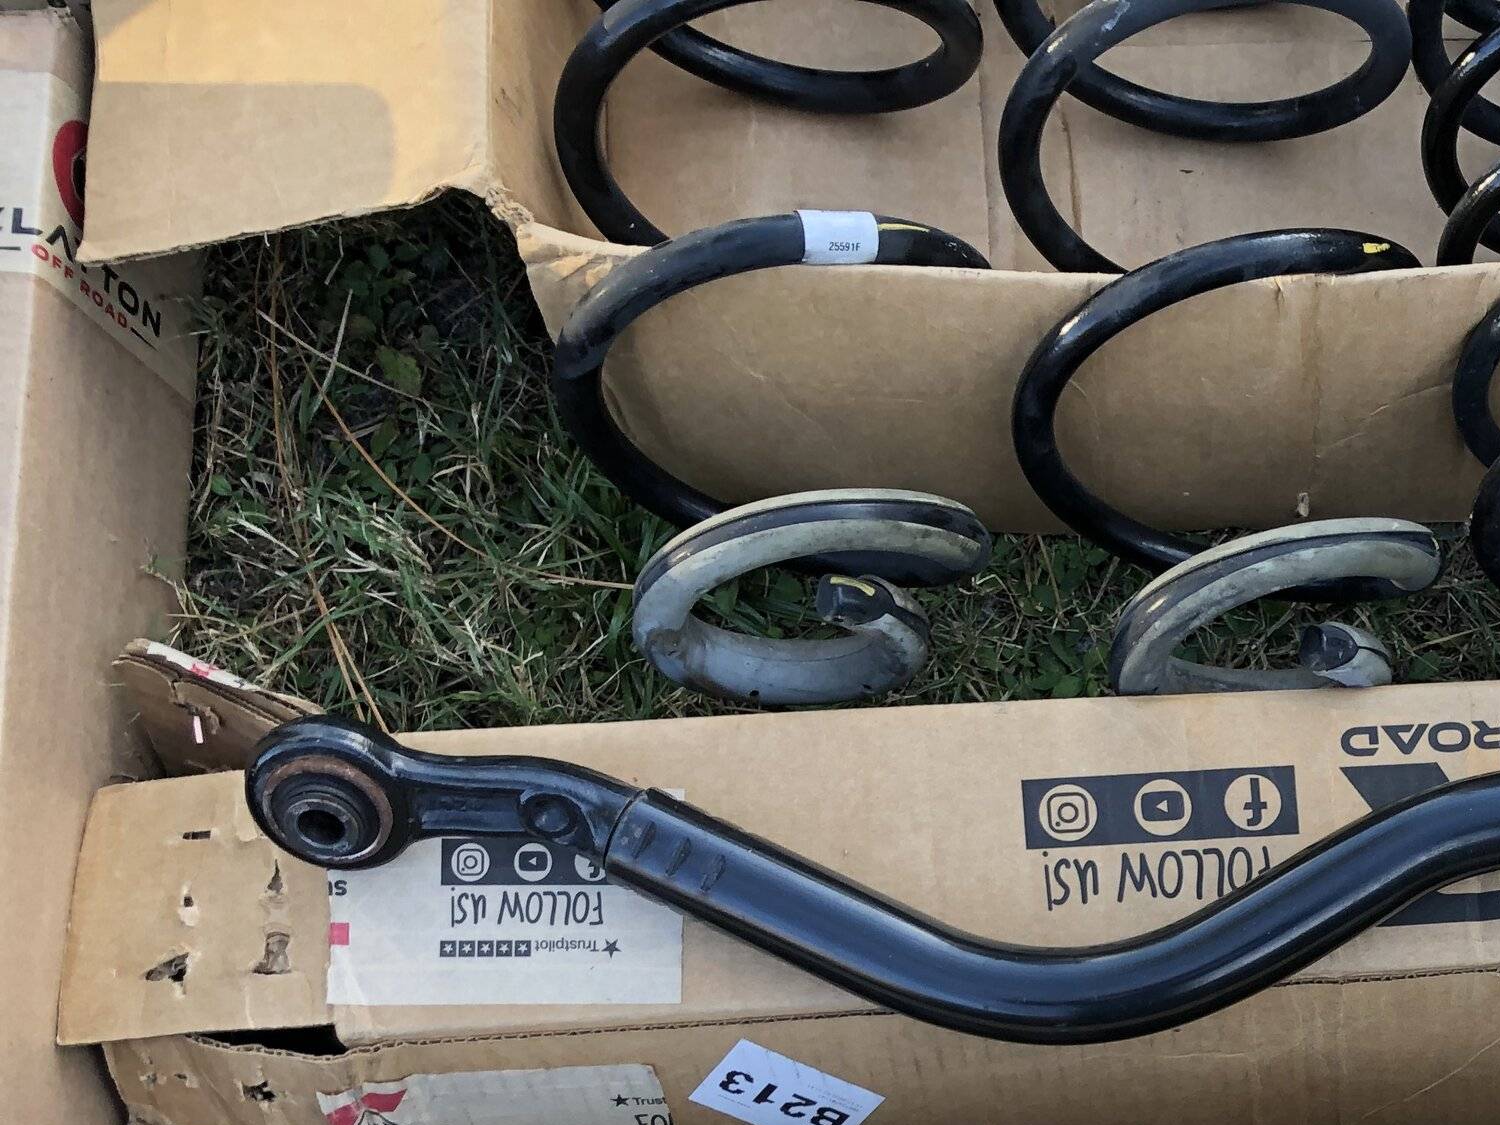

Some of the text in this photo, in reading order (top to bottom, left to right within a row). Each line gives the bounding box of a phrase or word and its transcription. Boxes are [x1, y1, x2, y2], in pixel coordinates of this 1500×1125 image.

[828, 241, 861, 252] 25591F
[79, 279, 127, 329] ROAD
[496, 890, 604, 926] FOLLOW
[535, 939, 600, 953] Trustpilot
